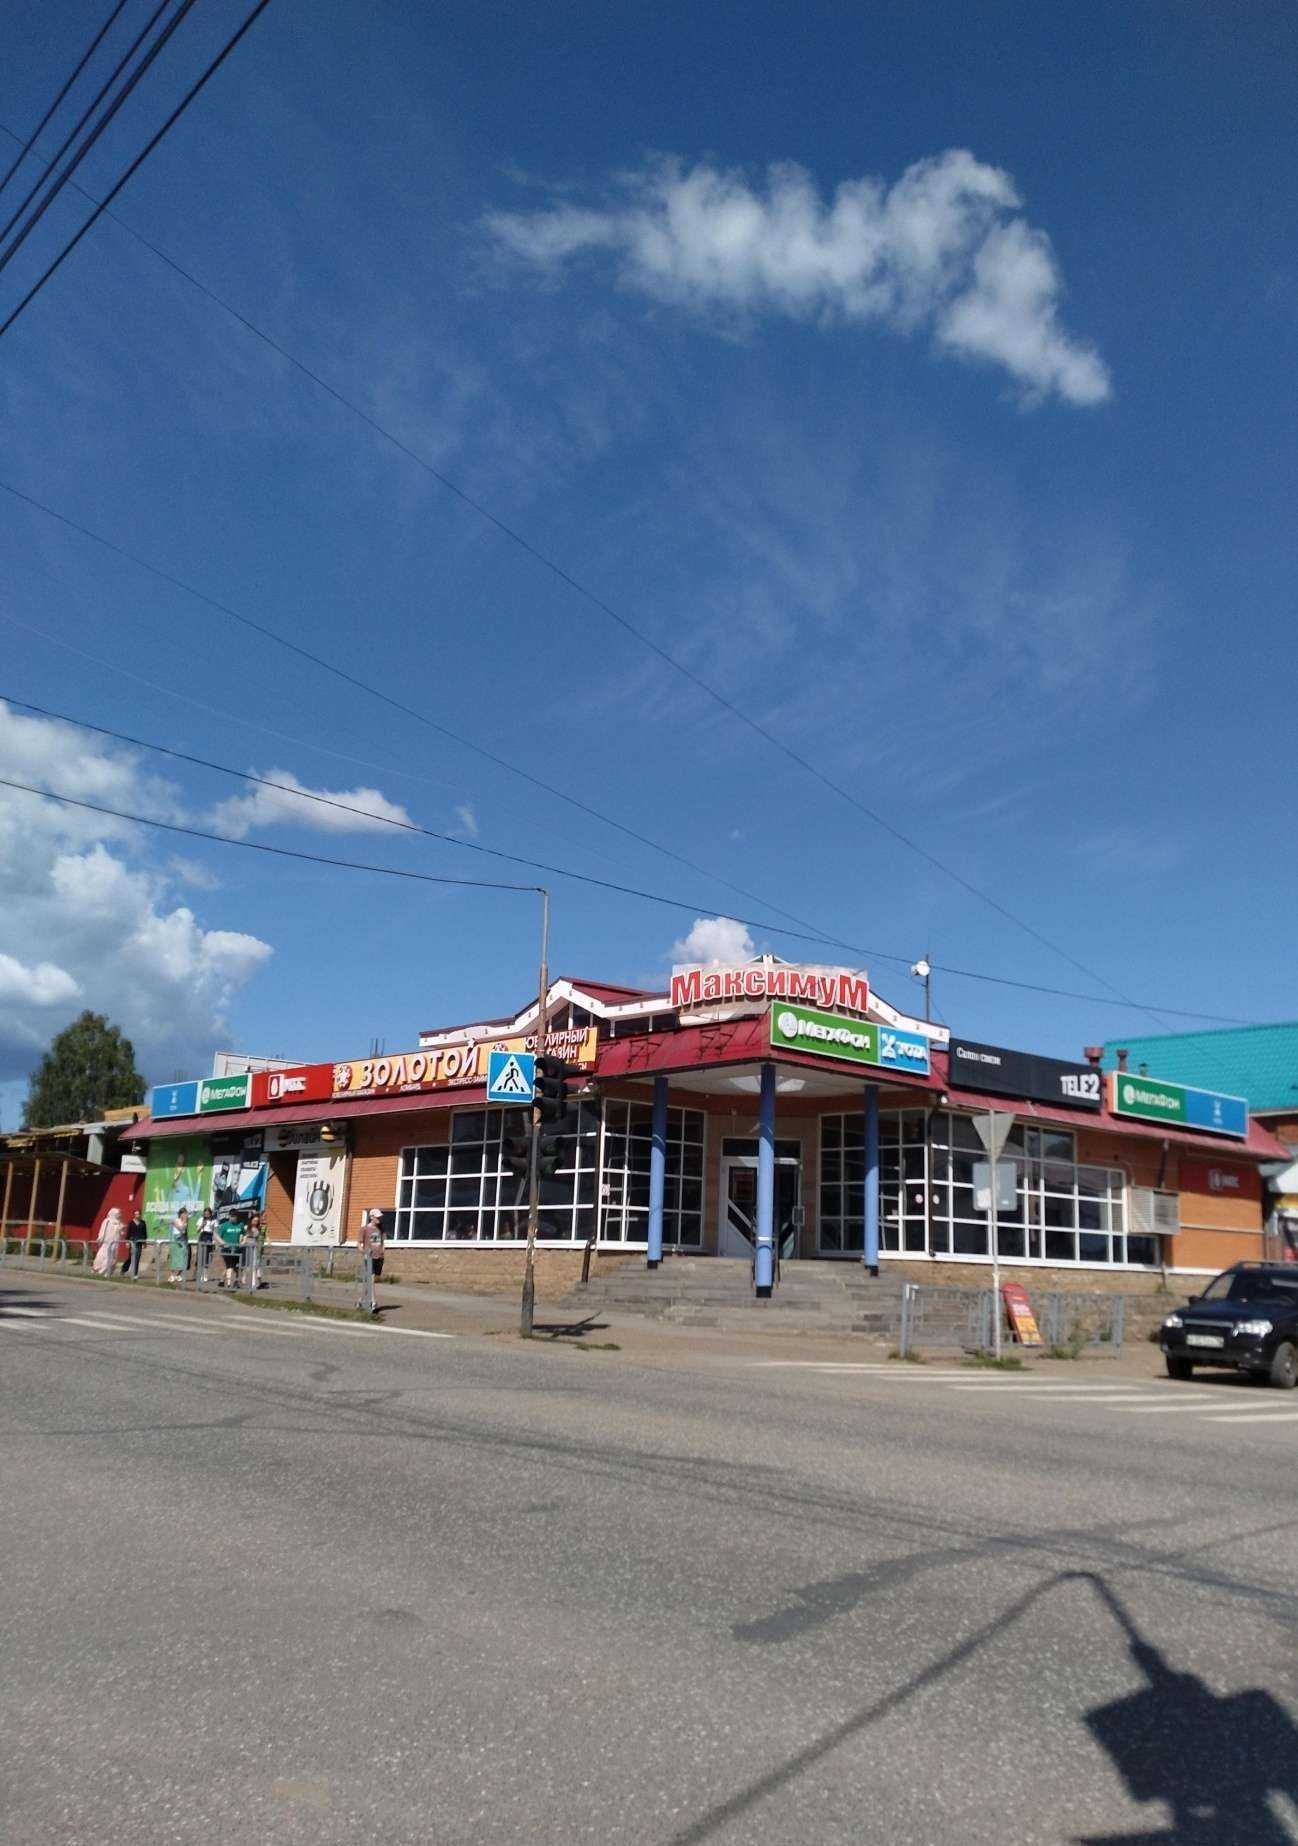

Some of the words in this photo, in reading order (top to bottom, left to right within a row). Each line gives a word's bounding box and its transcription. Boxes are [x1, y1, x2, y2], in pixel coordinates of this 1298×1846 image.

[525, 1026, 589, 1049] ЮЛИРНЫЙ
[359, 1037, 481, 1088] ЗОЛОТОЙ
[1060, 1073, 1101, 1101] TELE2
